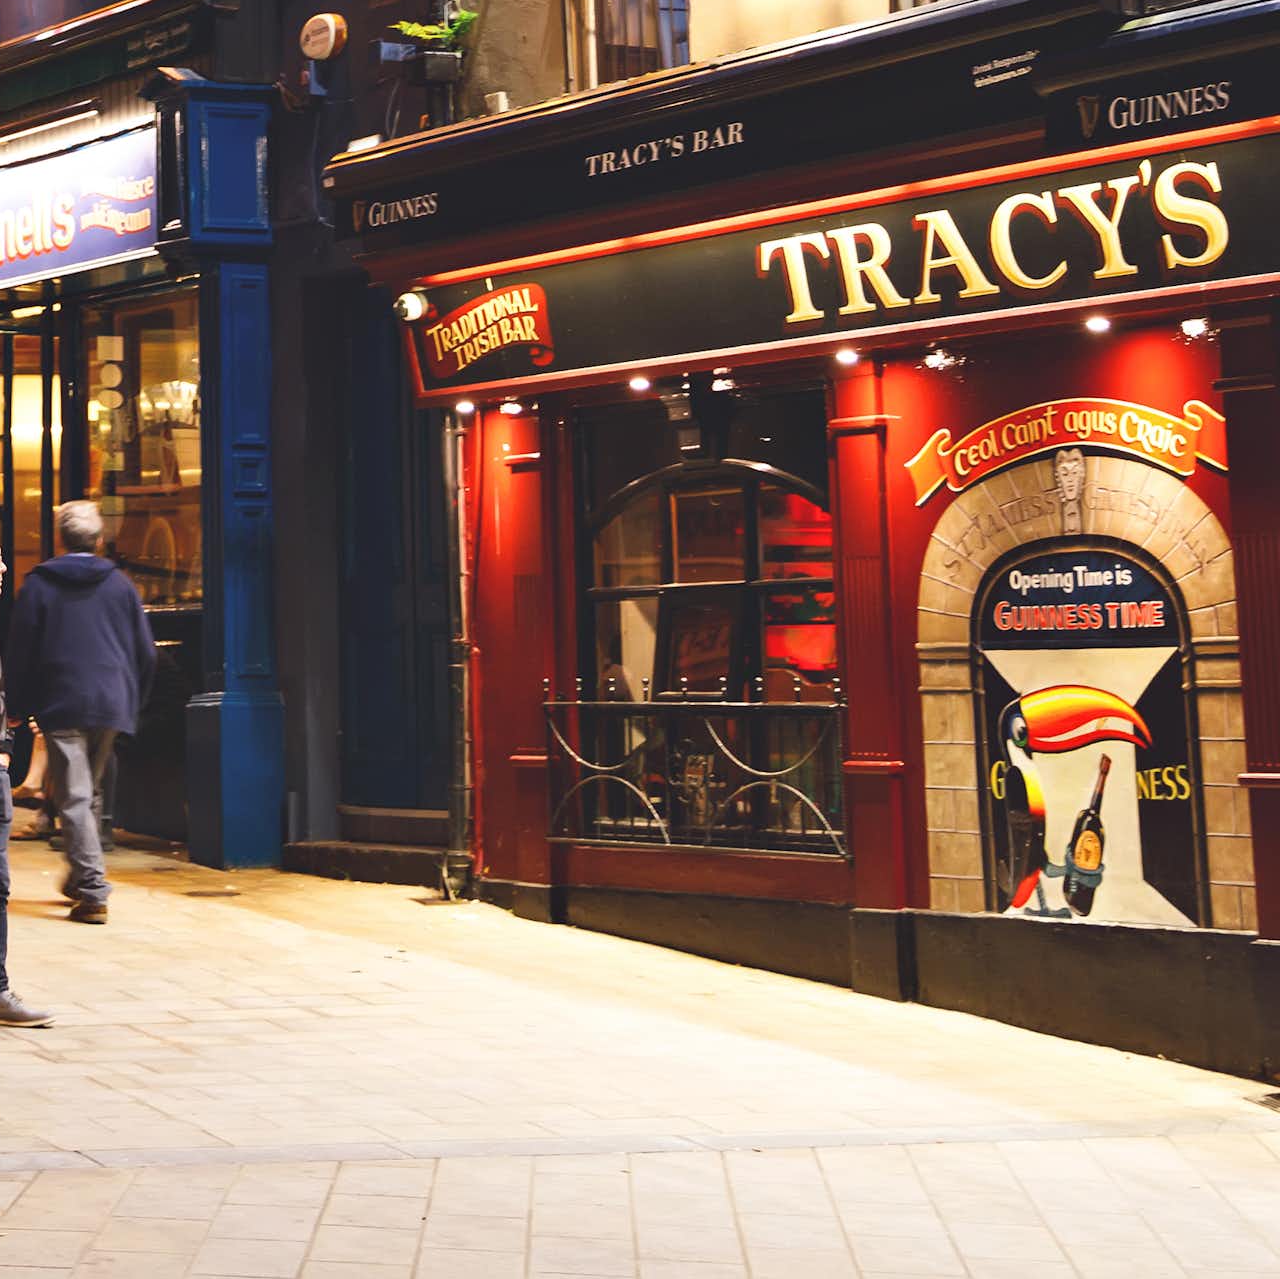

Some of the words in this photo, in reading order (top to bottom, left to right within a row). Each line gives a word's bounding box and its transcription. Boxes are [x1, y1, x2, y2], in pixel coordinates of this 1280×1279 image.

[1108, 81, 1232, 129] GUINNESS
[584, 134, 685, 177] TRACY'S
[692, 122, 745, 153] BAR
[368, 192, 438, 227] GUINNESS
[757, 159, 1231, 324] TRACY'S
[426, 288, 539, 361] TRADITIONAL
[453, 324, 501, 371] IRISH
[498, 315, 540, 345] BAR
[1002, 406, 1059, 451] Caint
[1063, 410, 1117, 439] agus
[1009, 568, 1074, 596] Opening
[1073, 565, 1113, 587] Time
[1114, 564, 1133, 586] is
[994, 601, 1103, 631] GUINNESS
[1105, 600, 1166, 629] TIME
